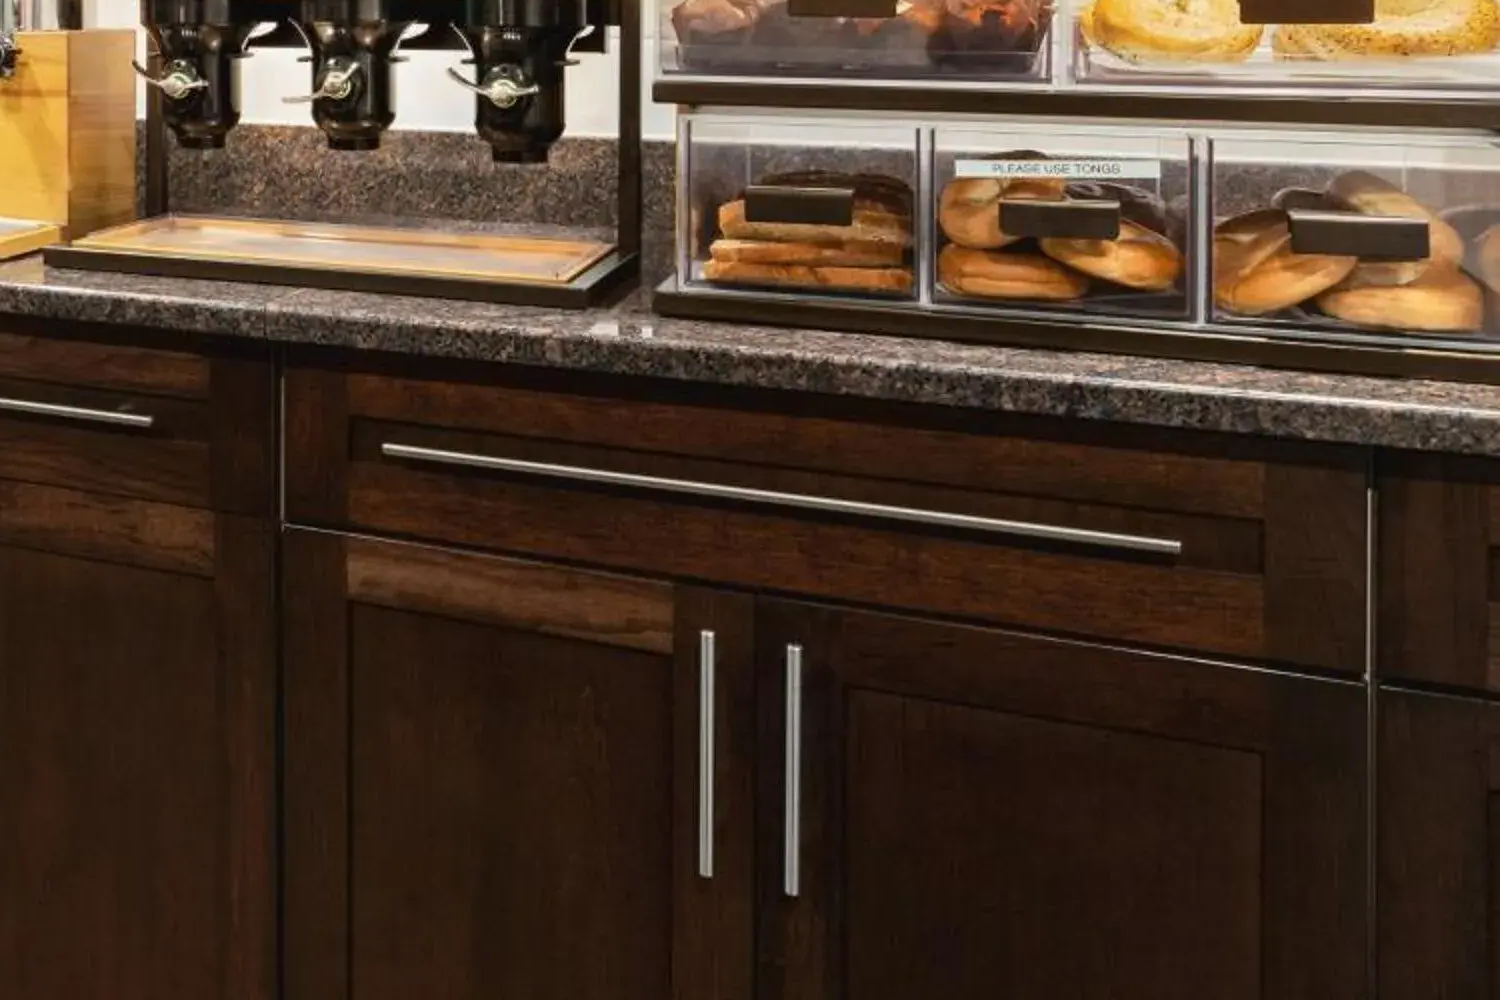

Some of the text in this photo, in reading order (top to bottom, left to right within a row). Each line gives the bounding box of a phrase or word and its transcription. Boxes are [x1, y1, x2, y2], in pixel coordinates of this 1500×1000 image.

[991, 163, 1122, 175] PLEASE USE TONGS
